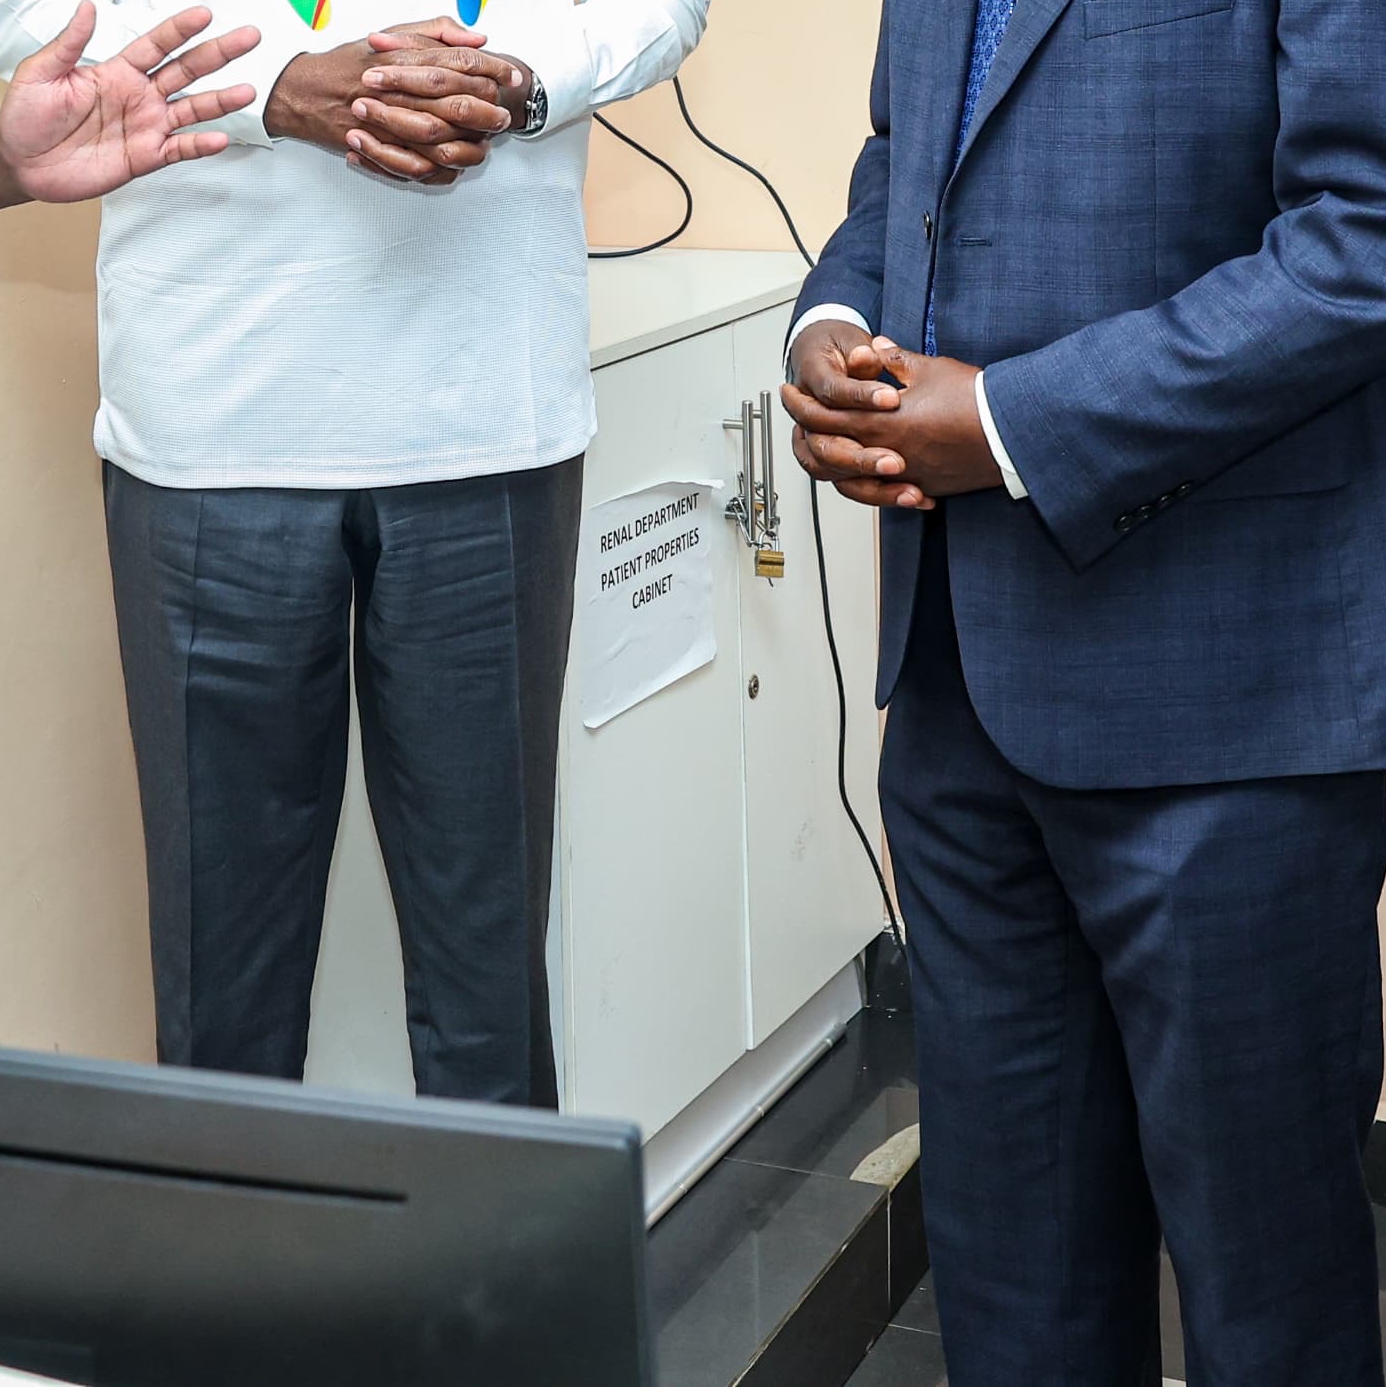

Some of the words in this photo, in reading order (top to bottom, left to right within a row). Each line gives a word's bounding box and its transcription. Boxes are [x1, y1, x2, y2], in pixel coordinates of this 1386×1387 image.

[600, 521, 635, 554] RENAL
[634, 493, 700, 538] DEPARTMENT
[600, 554, 643, 592] PATIENT
[644, 528, 700, 569] PROPERTIES
[631, 575, 674, 609] CABINET
